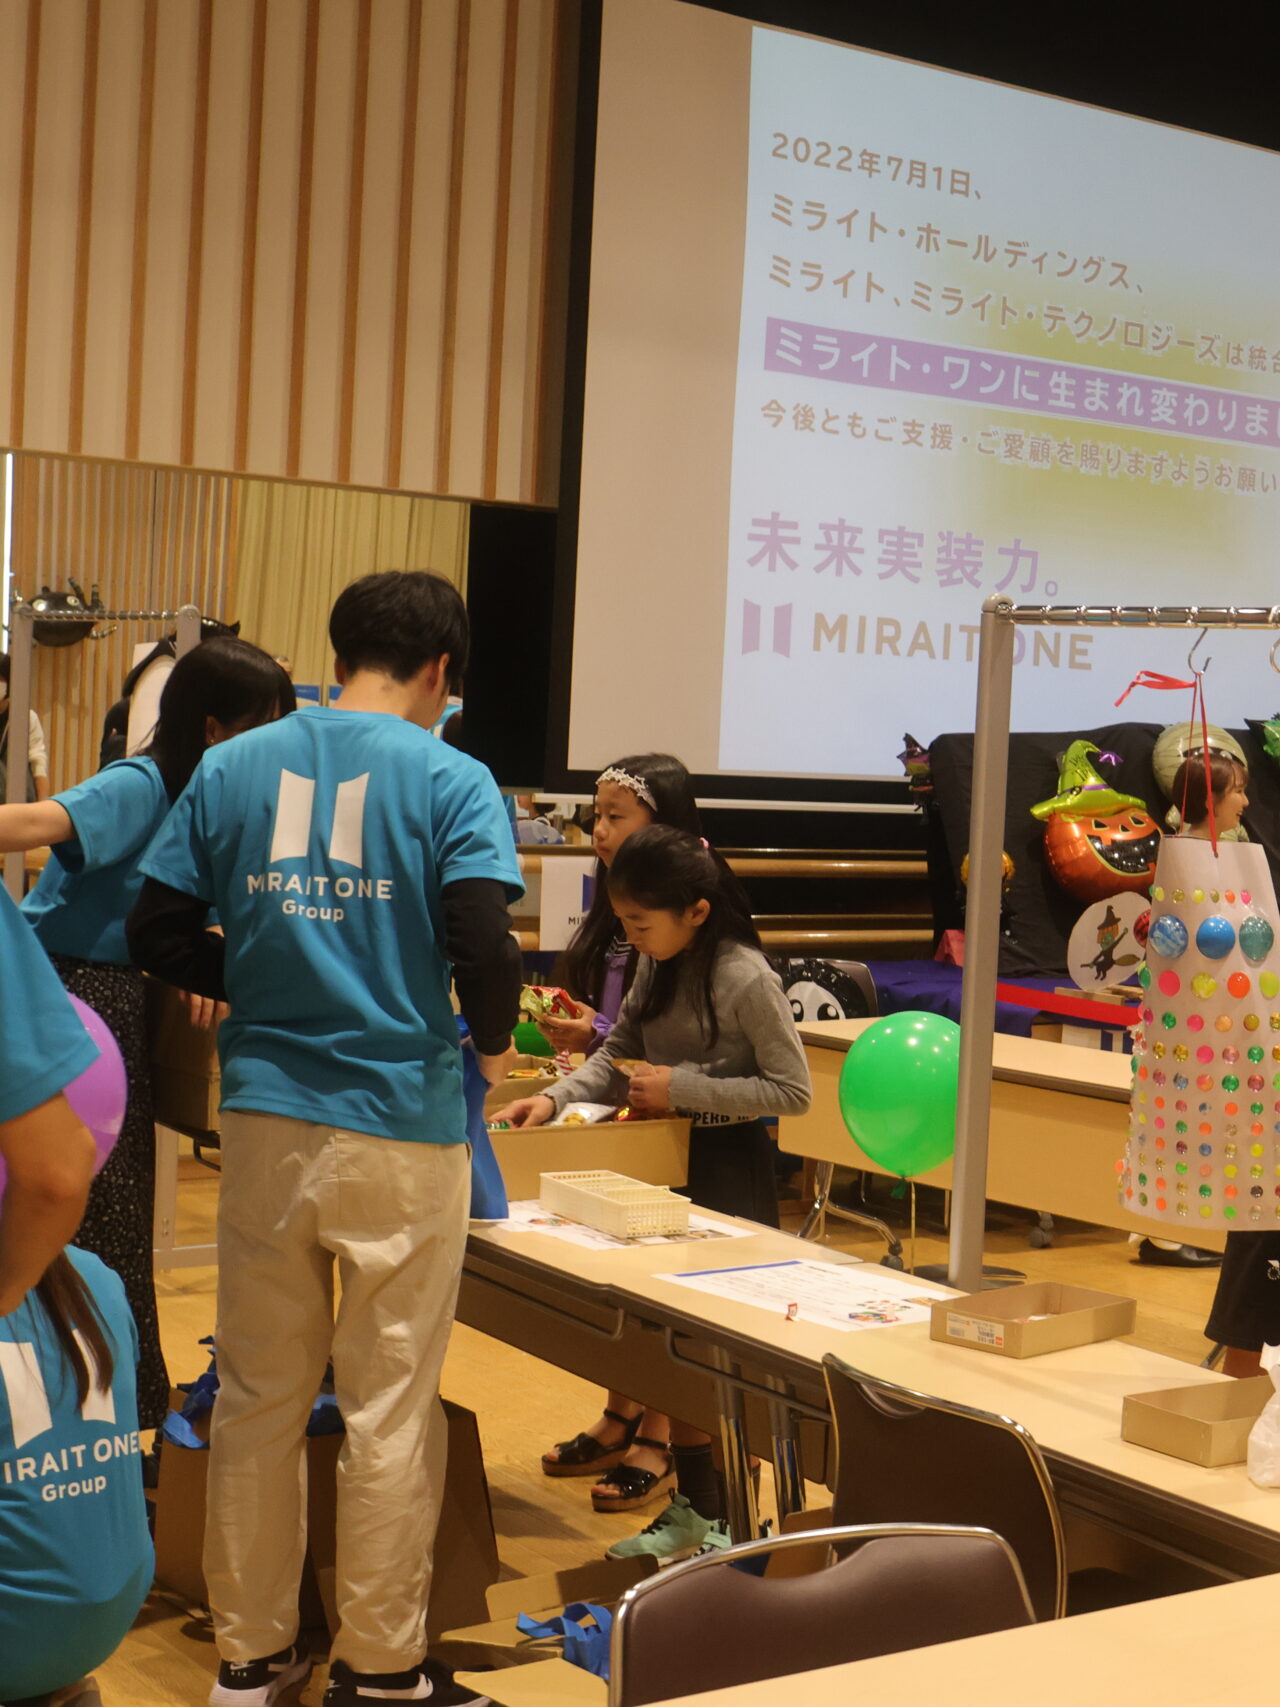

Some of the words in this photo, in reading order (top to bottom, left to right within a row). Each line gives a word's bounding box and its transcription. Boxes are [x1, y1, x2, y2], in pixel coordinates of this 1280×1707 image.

[771, 132, 983, 200] 2022年7月1日、
[769, 192, 1145, 294] ミライト・ホールディングス、
[746, 510, 1059, 598] 未来実装力。
[812, 612, 981, 663] MIRAIT
[334, 876, 394, 900] ONE
[281, 899, 345, 923] Group
[93, 1430, 139, 1463] ONE
[41, 1475, 108, 1502] Group
